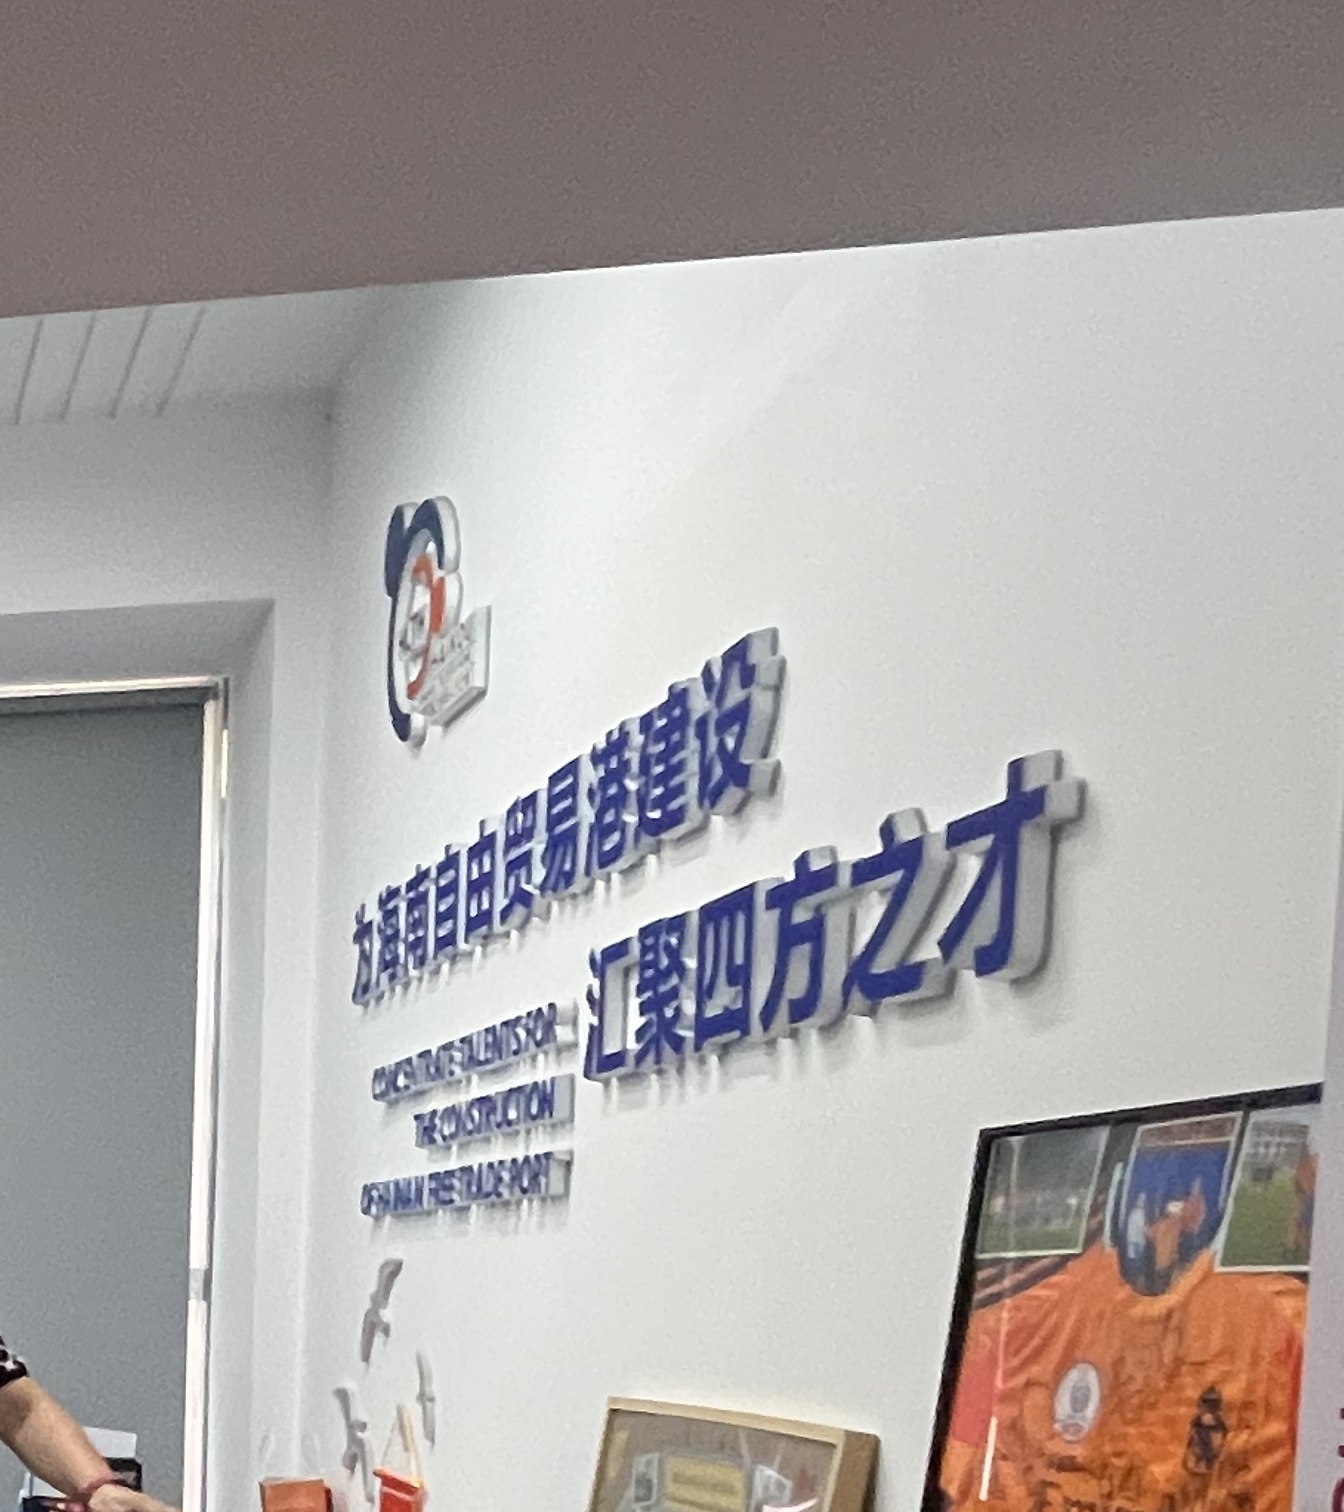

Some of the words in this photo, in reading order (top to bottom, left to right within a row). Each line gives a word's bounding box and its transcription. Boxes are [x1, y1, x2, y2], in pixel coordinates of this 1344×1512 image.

[352, 630, 776, 1004] 为海南自由贸易港建设
[585, 752, 1062, 1082] 汇聚四方之才
